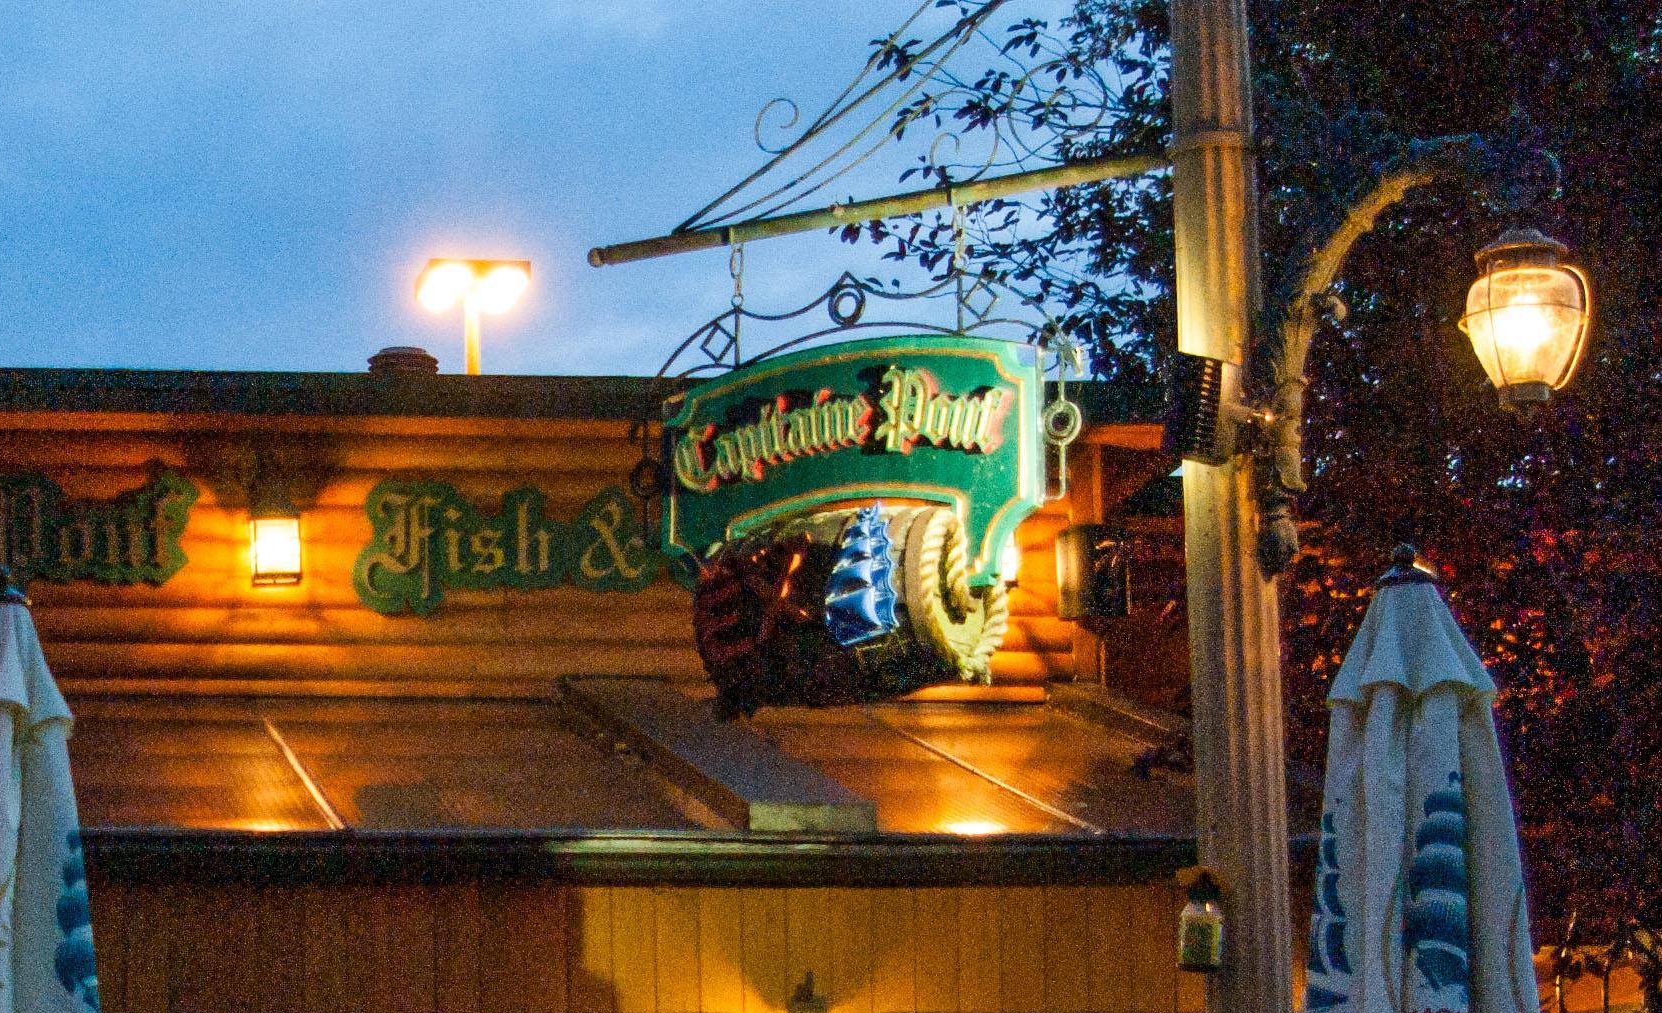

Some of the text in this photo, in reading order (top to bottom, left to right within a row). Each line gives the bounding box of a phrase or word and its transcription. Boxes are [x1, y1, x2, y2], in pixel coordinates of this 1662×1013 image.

[676, 364, 1014, 492] Capitaine Pouf
[366, 494, 646, 599] Fish &
